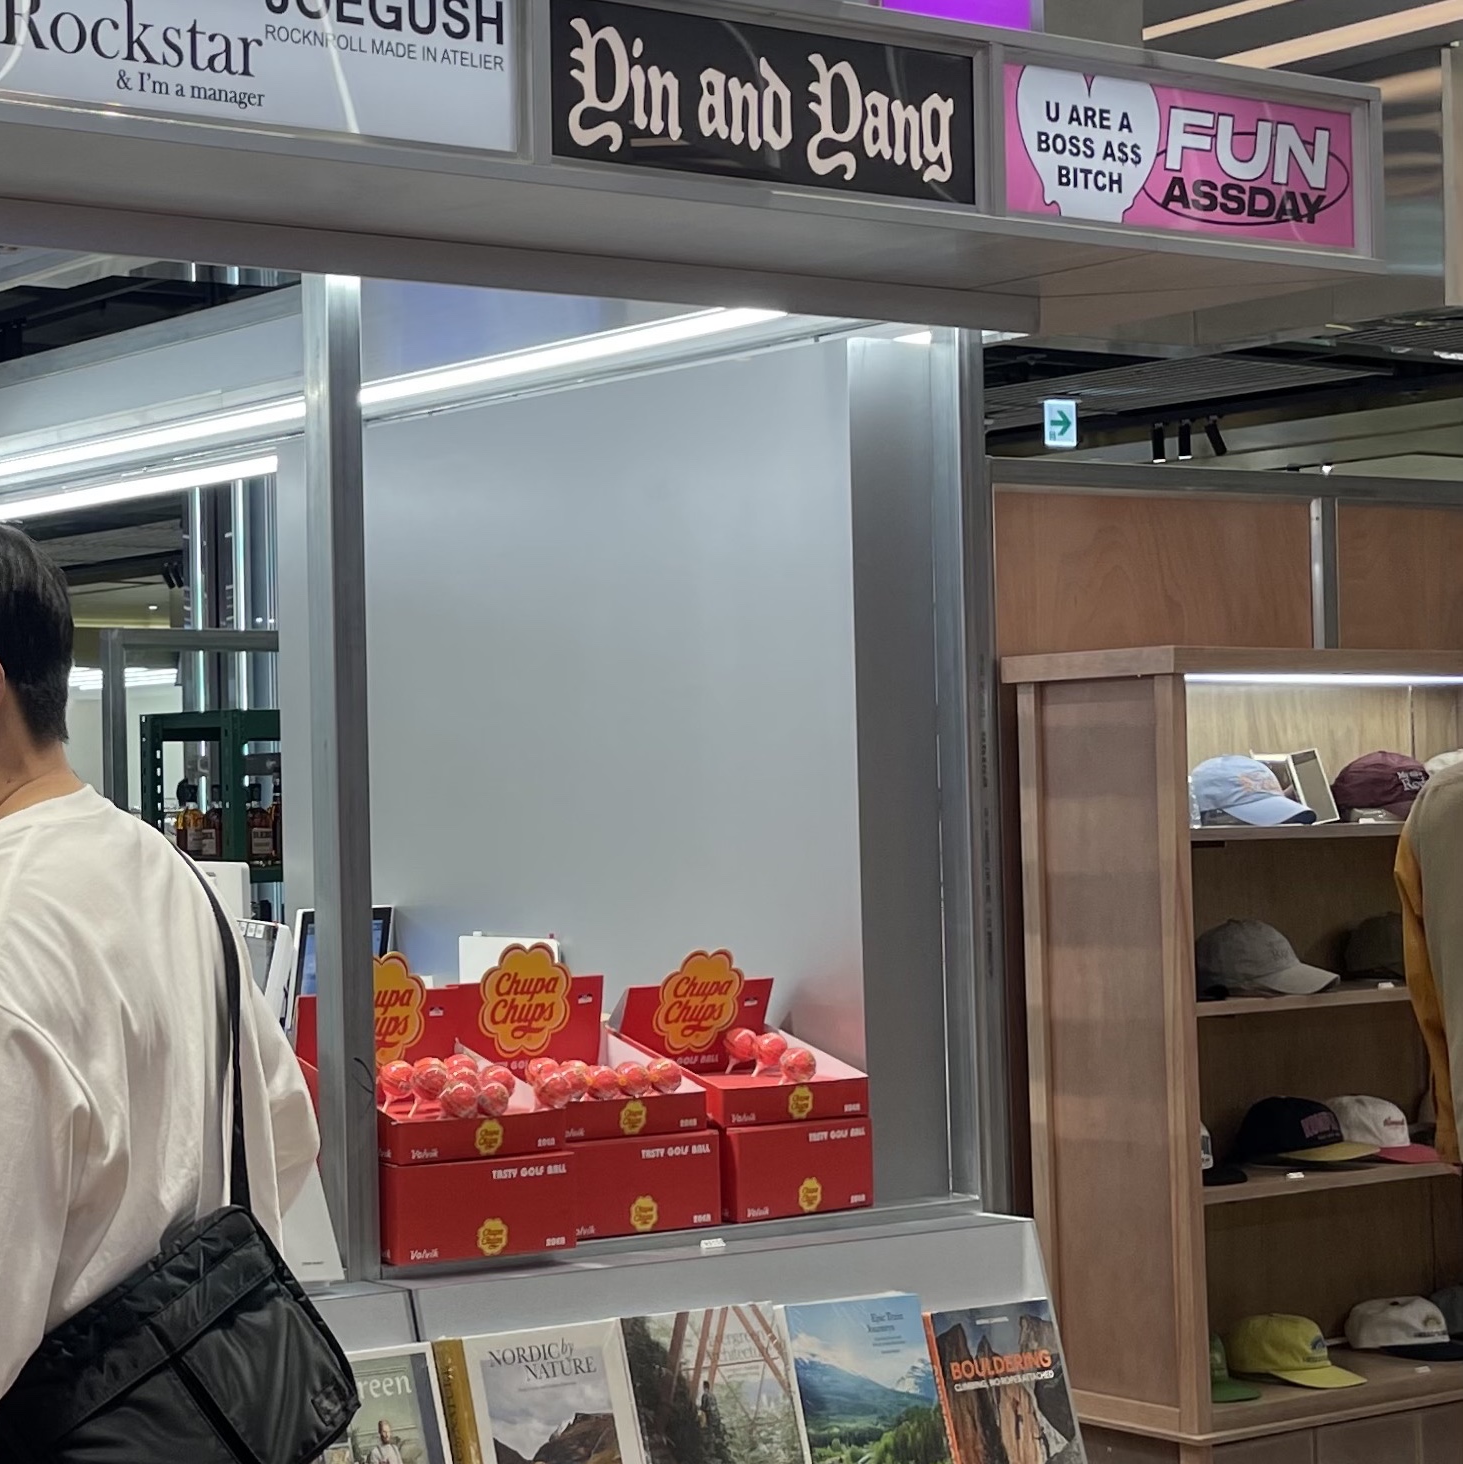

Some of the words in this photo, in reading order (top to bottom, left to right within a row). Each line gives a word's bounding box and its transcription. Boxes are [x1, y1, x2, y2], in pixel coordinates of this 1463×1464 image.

[265, 24, 367, 54] ROCKNROLL
[371, 40, 418, 60] MADE
[422, 45, 437, 62] IN
[441, 49, 505, 72] ATELIER
[116, 69, 133, 91] &
[138, 72, 169, 96] I'm
[174, 83, 185, 98] a
[190, 83, 266, 110] manager
[568, 16, 682, 154] Yin
[697, 57, 793, 153] and
[807, 52, 956, 184] Yang
[1045, 101, 1062, 124] U
[1066, 104, 1112, 130] ARE
[1116, 109, 1133, 132] A
[1036, 130, 1095, 159] BOSS
[1101, 137, 1143, 167] A$$
[1165, 108, 1332, 191] FUN
[1057, 165, 1124, 194] BITCH
[1161, 177, 1329, 224] ASSDAY
[375, 988, 414, 1014] upa
[495, 972, 560, 1008] Chupa
[673, 975, 734, 1004] Chupa
[375, 1015, 410, 1037] ups
[490, 998, 555, 1036] Chups
[664, 999, 726, 1035] Chups
[667, 1145, 689, 1157] GOLF
[491, 1167, 517, 1180] TASTY
[520, 1164, 544, 1177] GOLF
[546, 1163, 567, 1175] BALL
[488, 1342, 560, 1368] NORDIC
[560, 1337, 575, 1358] by
[525, 1355, 598, 1381] NATURE
[949, 1349, 1052, 1381] BOULDERING
[357, 1375, 412, 1400] reen
